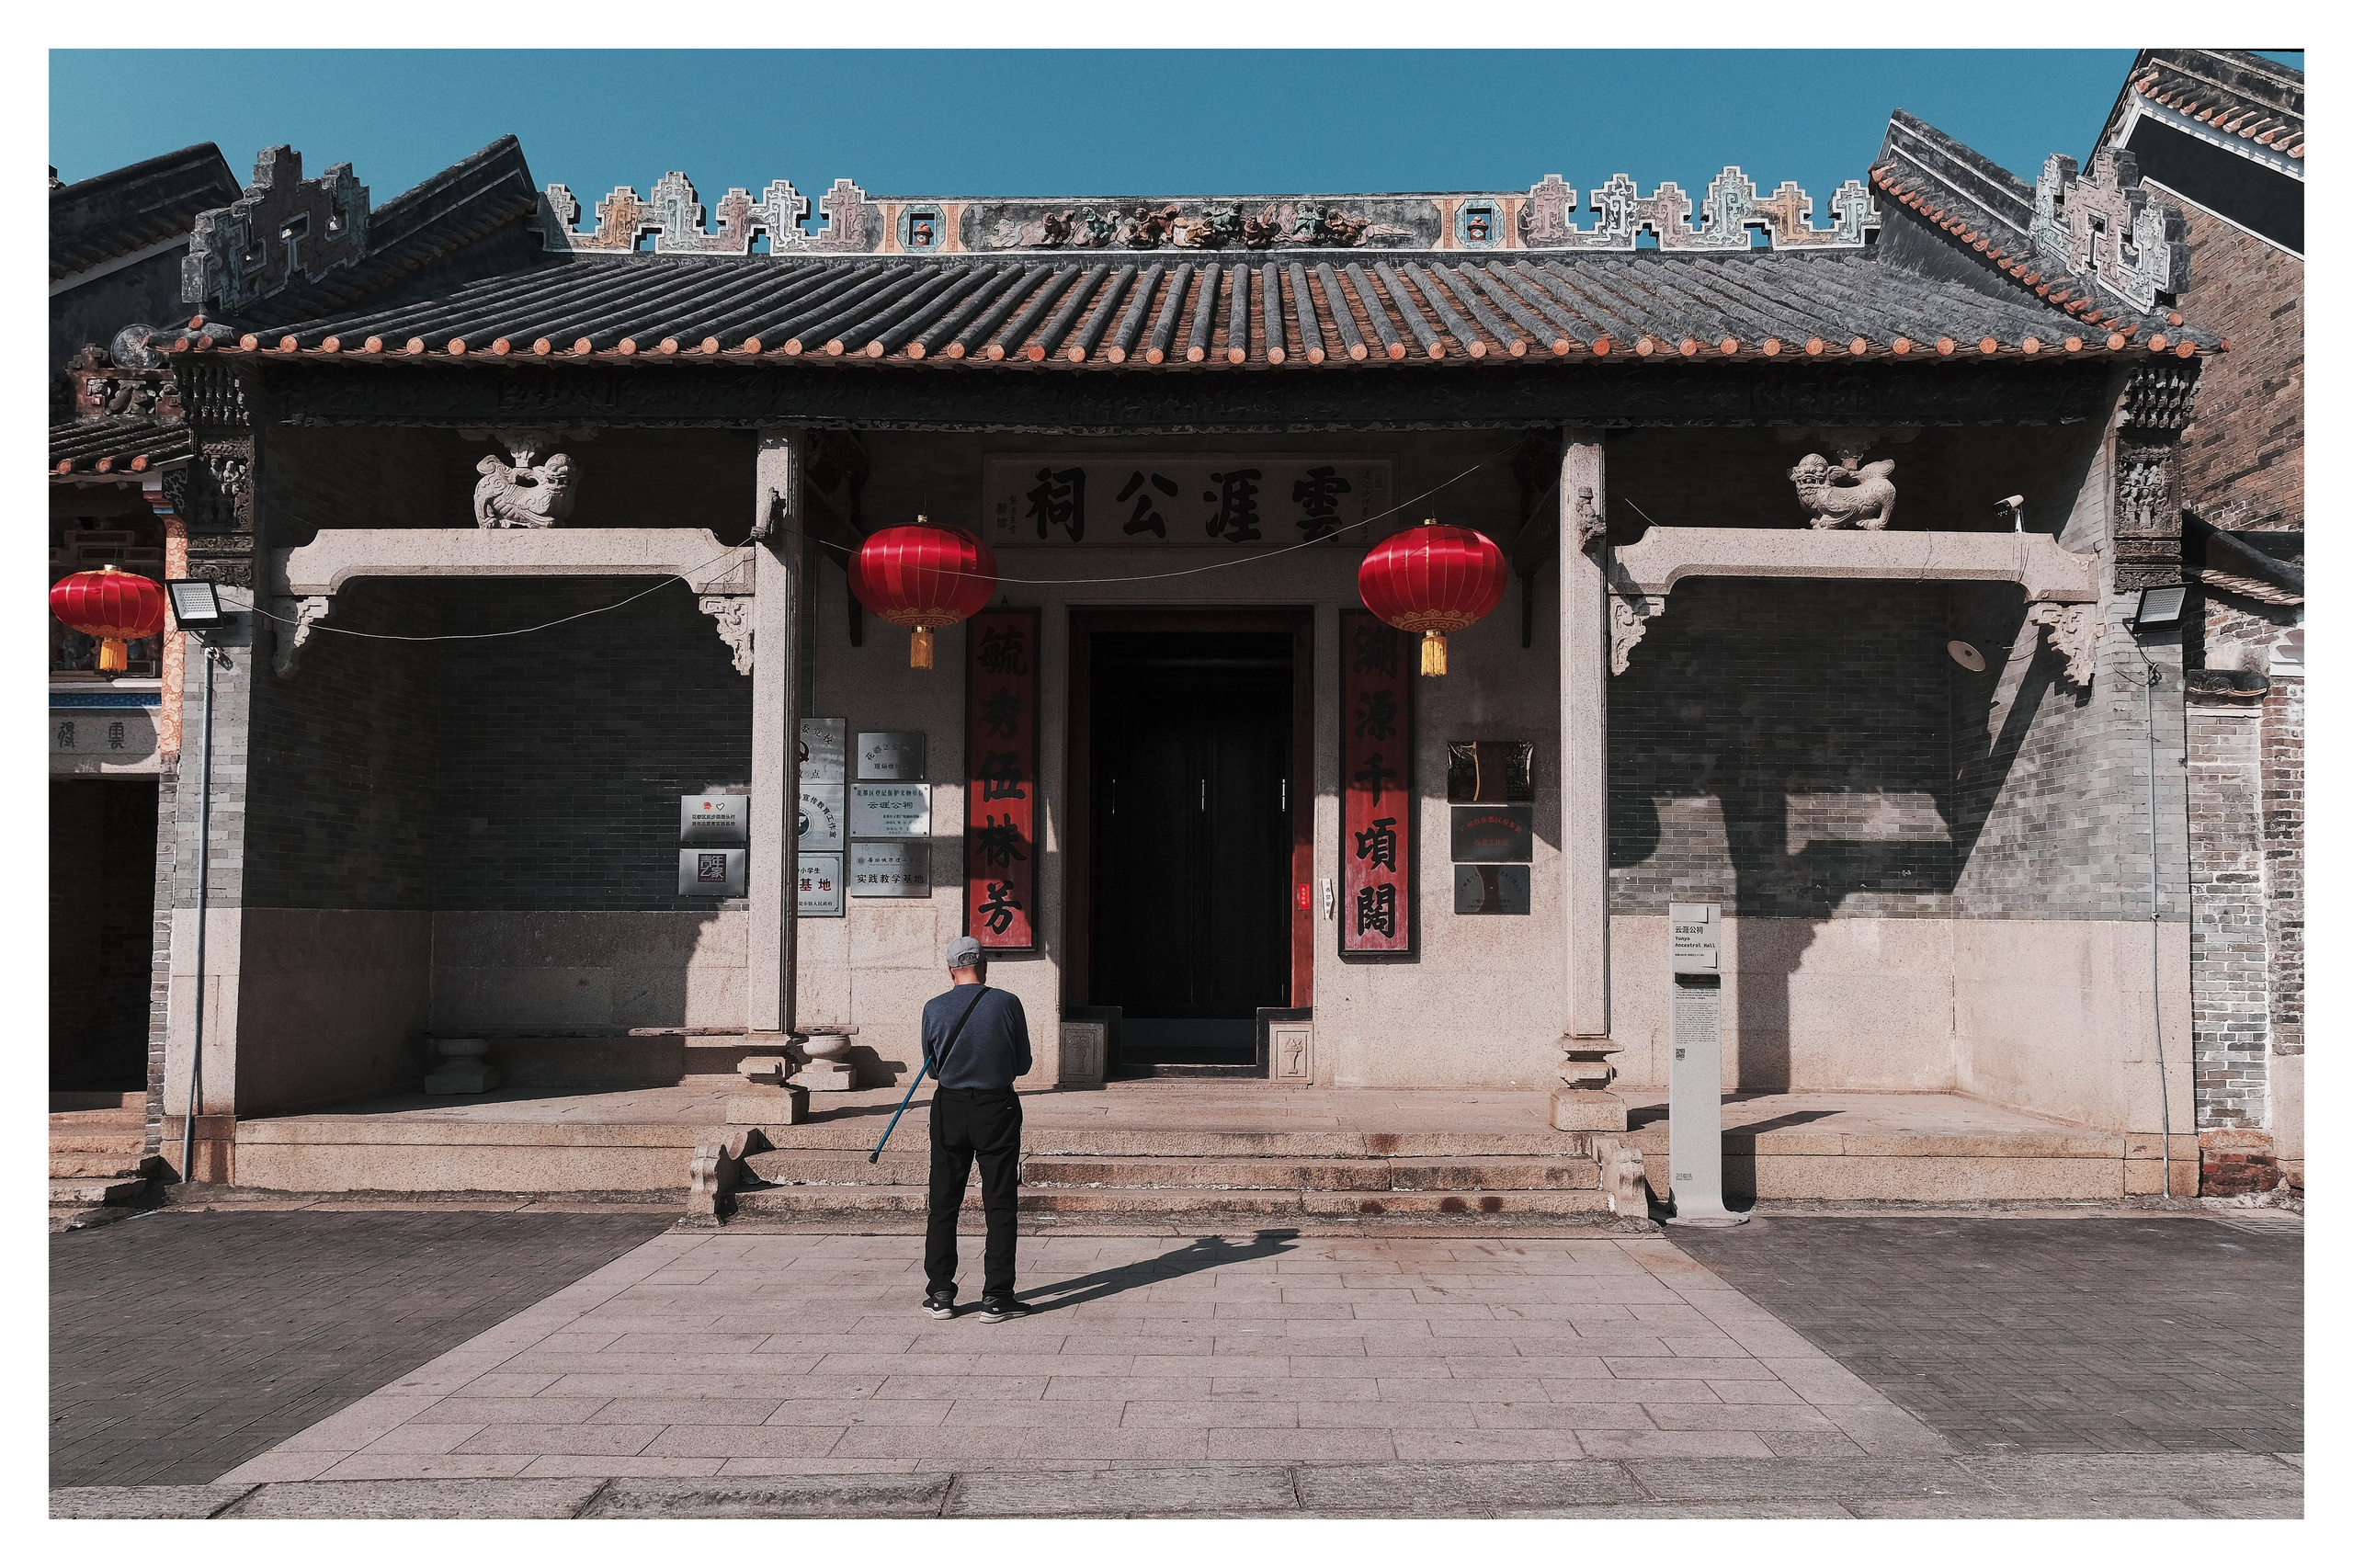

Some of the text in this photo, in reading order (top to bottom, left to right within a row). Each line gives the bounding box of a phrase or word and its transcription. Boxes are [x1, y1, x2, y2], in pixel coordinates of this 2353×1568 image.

[1026, 466, 1351, 542] 雲涯公祠
[868, 800, 914, 809] 云涯公祠
[799, 793, 837, 839] 宣传教育工作室
[800, 878, 832, 892] 基地
[857, 873, 924, 884] 实践教学基地
